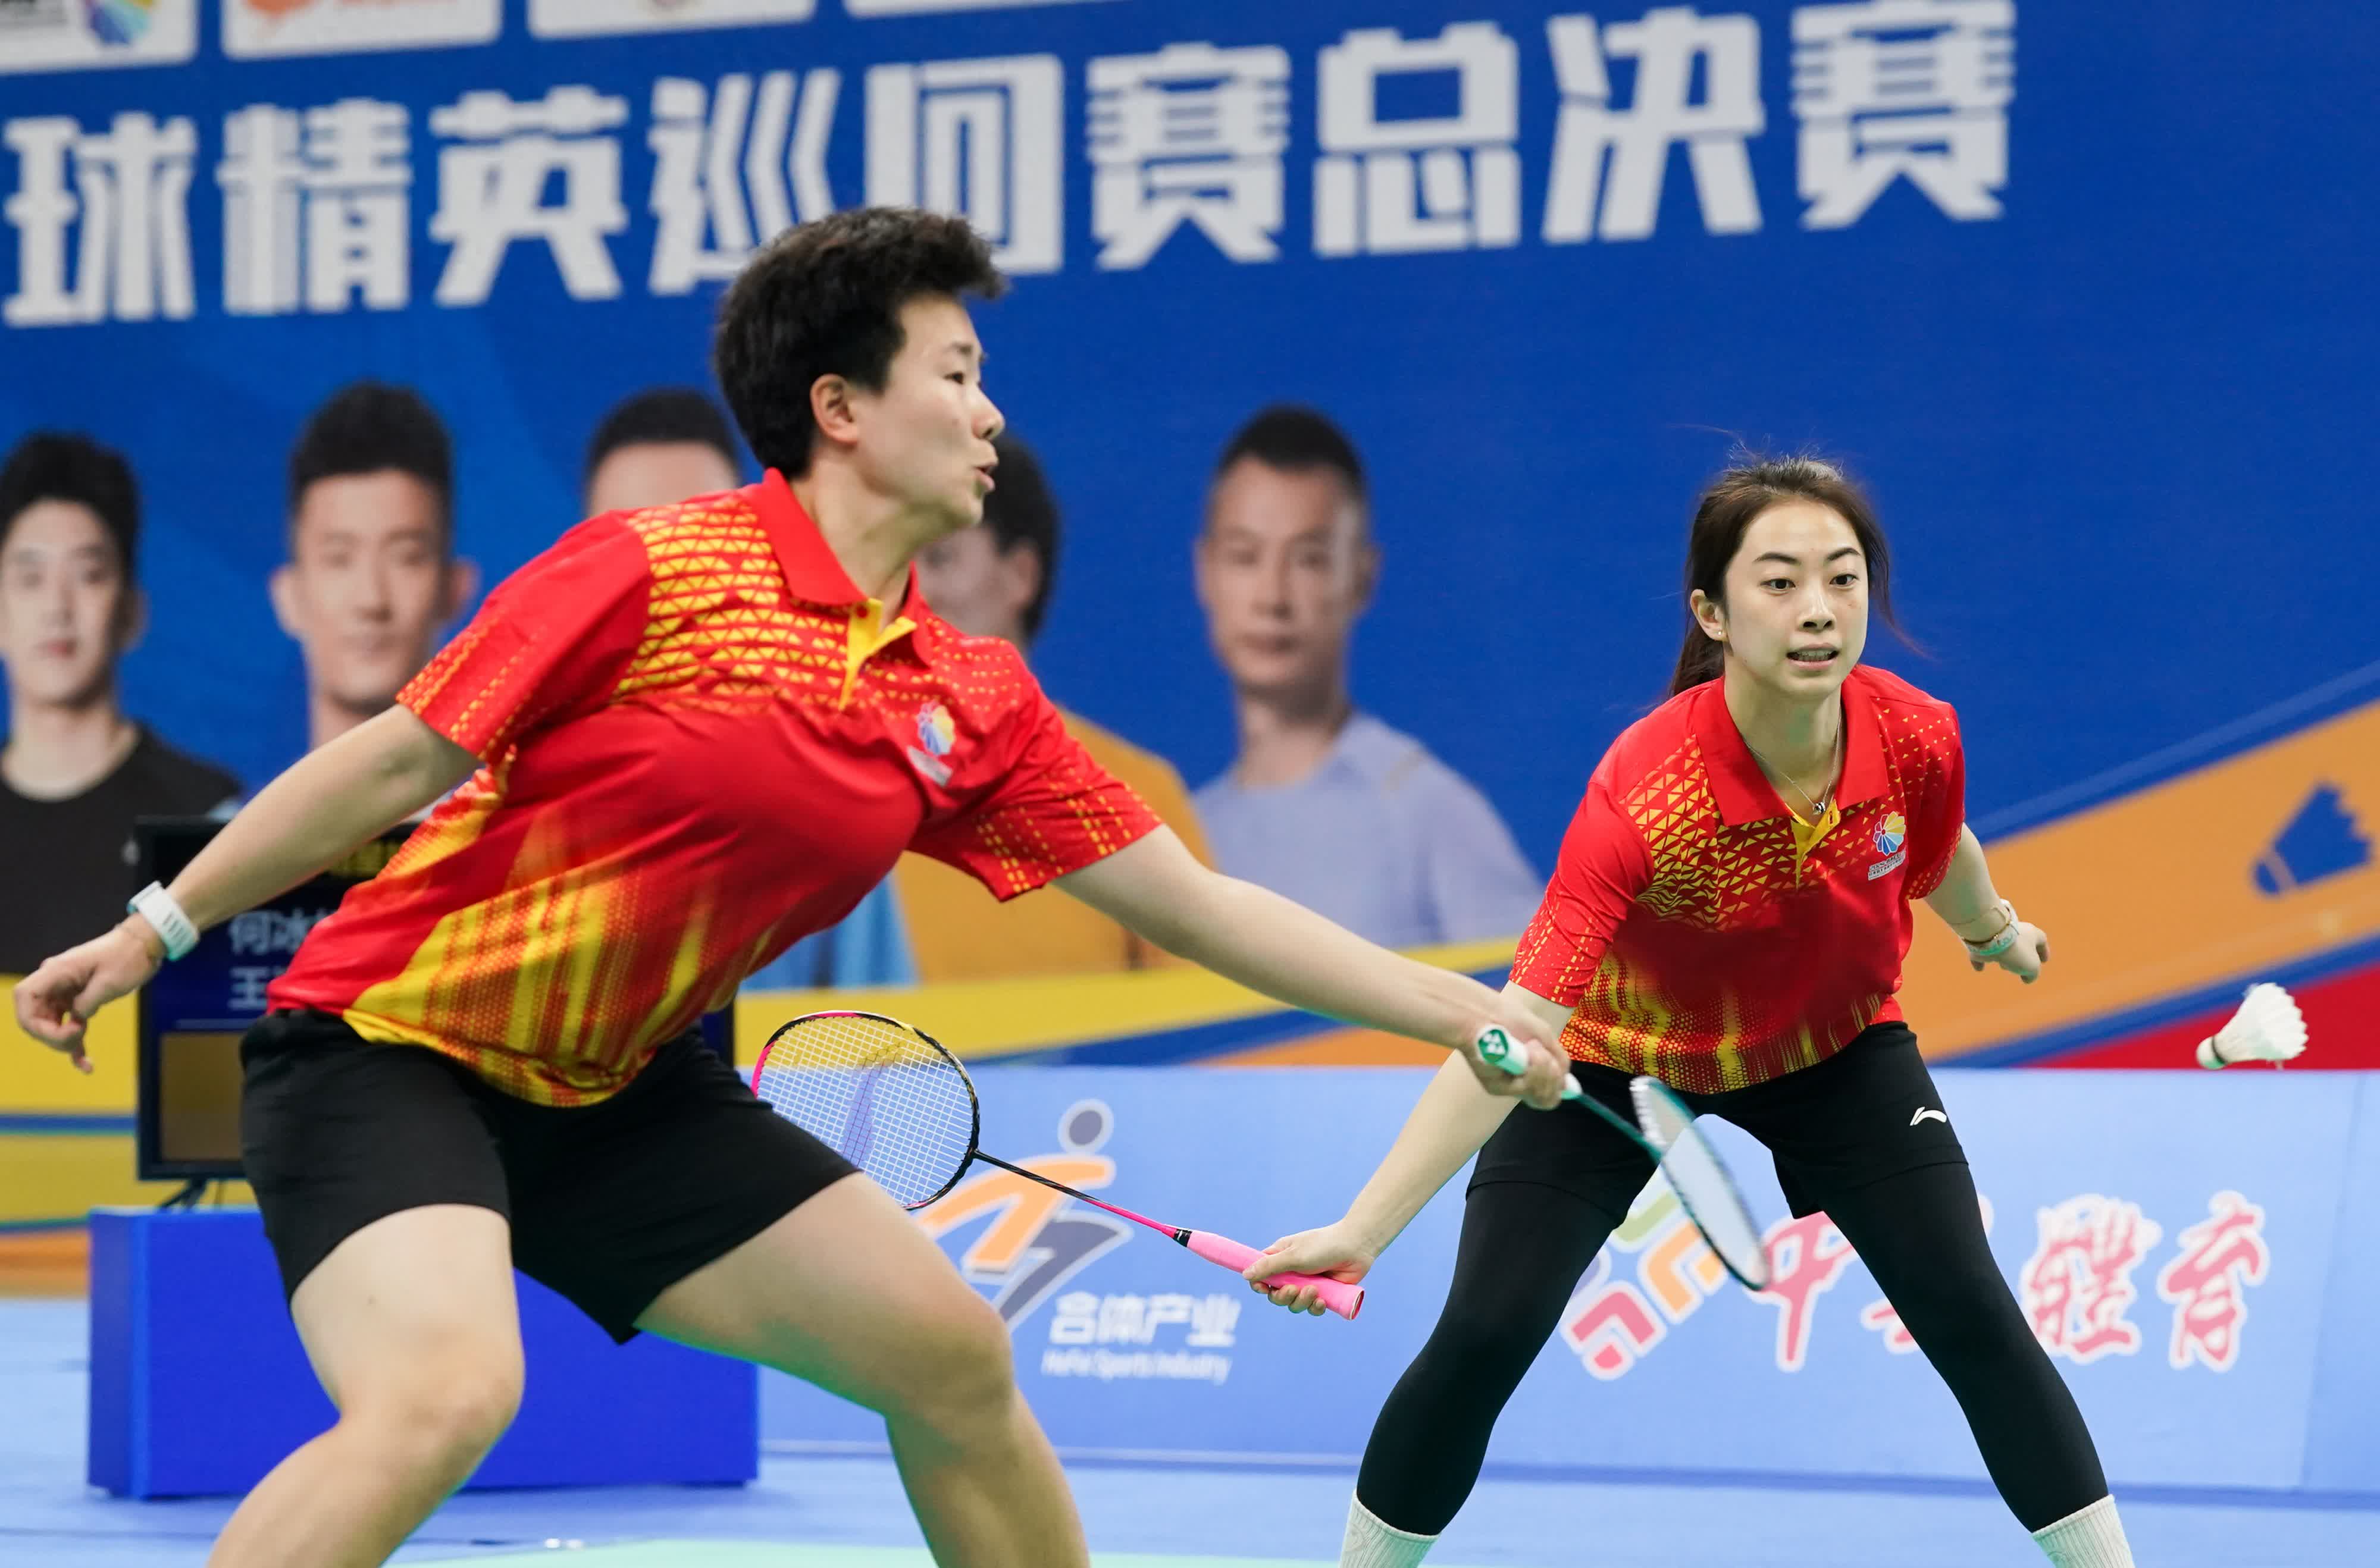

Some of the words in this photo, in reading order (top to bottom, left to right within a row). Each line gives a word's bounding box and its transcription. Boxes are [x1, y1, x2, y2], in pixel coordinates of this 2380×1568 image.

[3, 0, 2016, 327] 球精英巡回赛总决赛
[1048, 1291, 1242, 1347] 合体产业
[1748, 1191, 2269, 1370] 中體育
[1094, 1348, 1151, 1381] Sports
[1153, 1349, 1232, 1386] Industry
